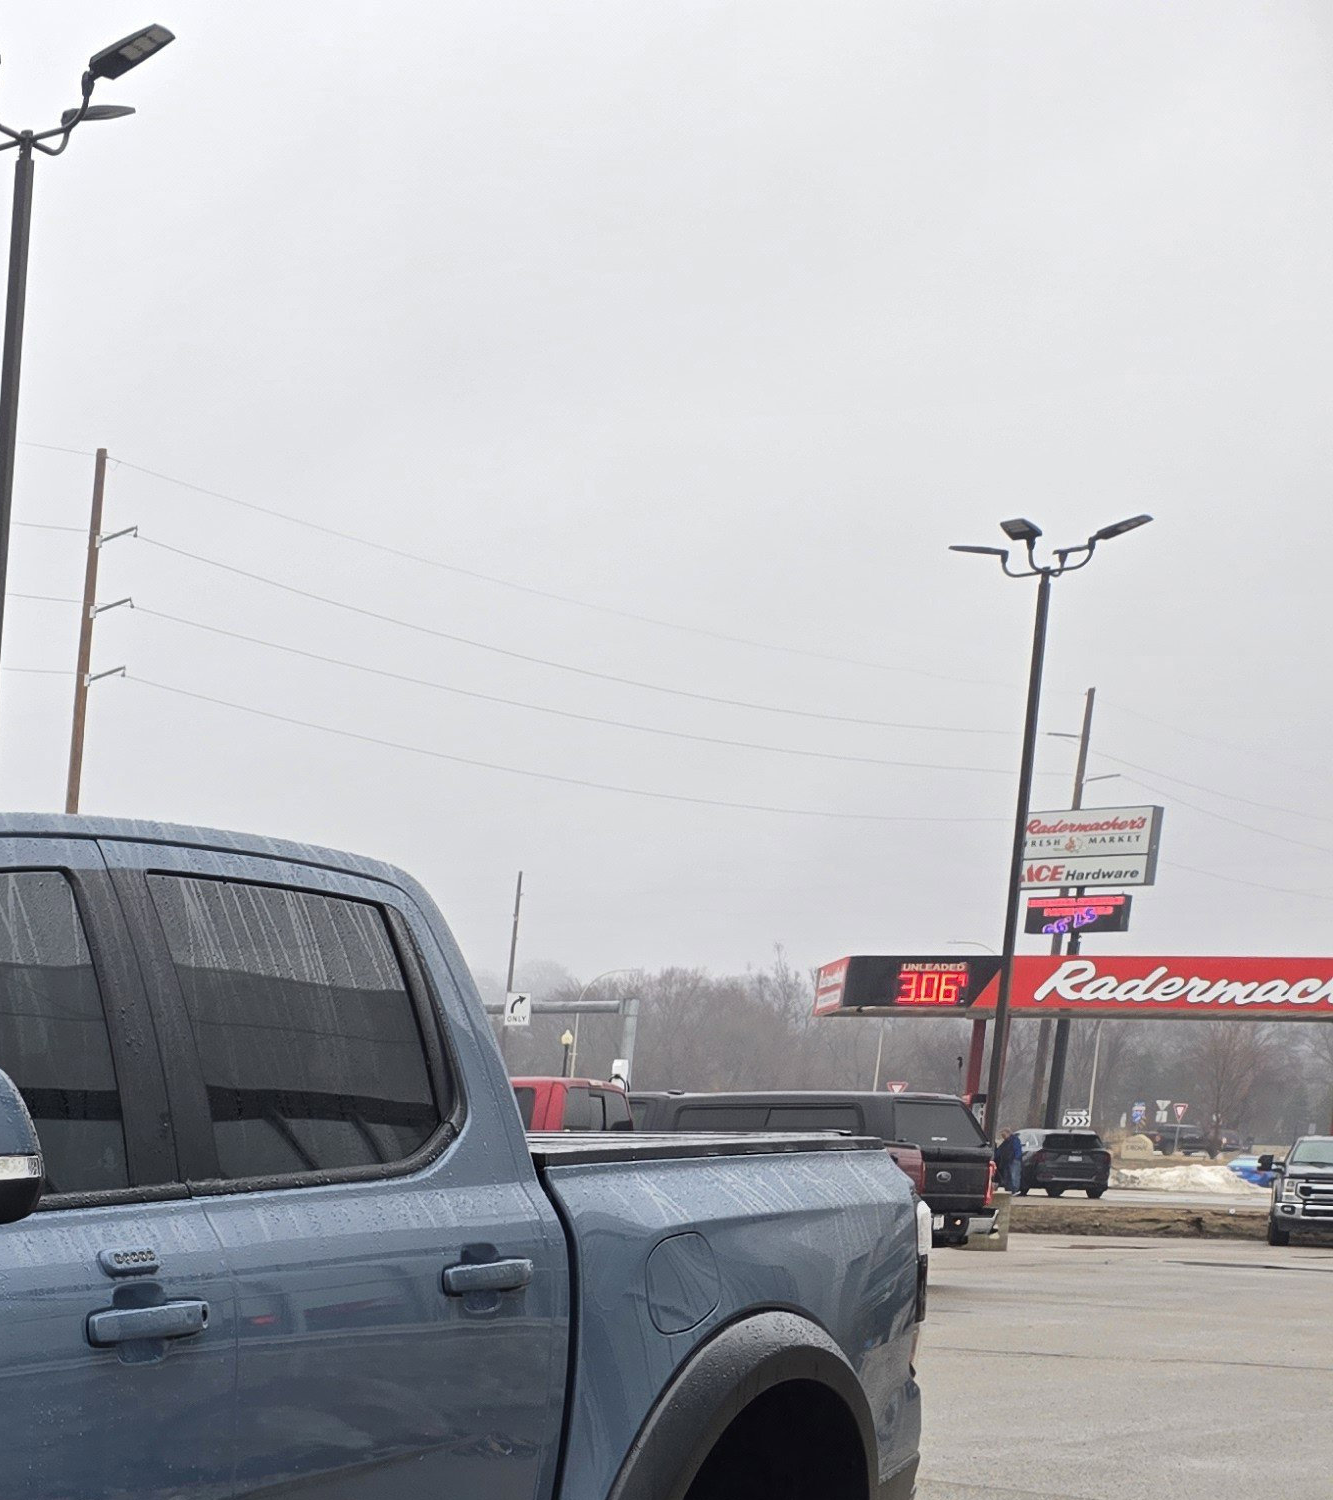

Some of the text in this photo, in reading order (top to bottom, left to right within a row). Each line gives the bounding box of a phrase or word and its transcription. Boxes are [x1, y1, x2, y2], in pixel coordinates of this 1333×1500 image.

[1025, 816, 1147, 836] Radermacher's
[1088, 835, 1141, 844] MARKET
[1019, 863, 1140, 883] ACE Hardware
[902, 962, 967, 972] UNLEADED
